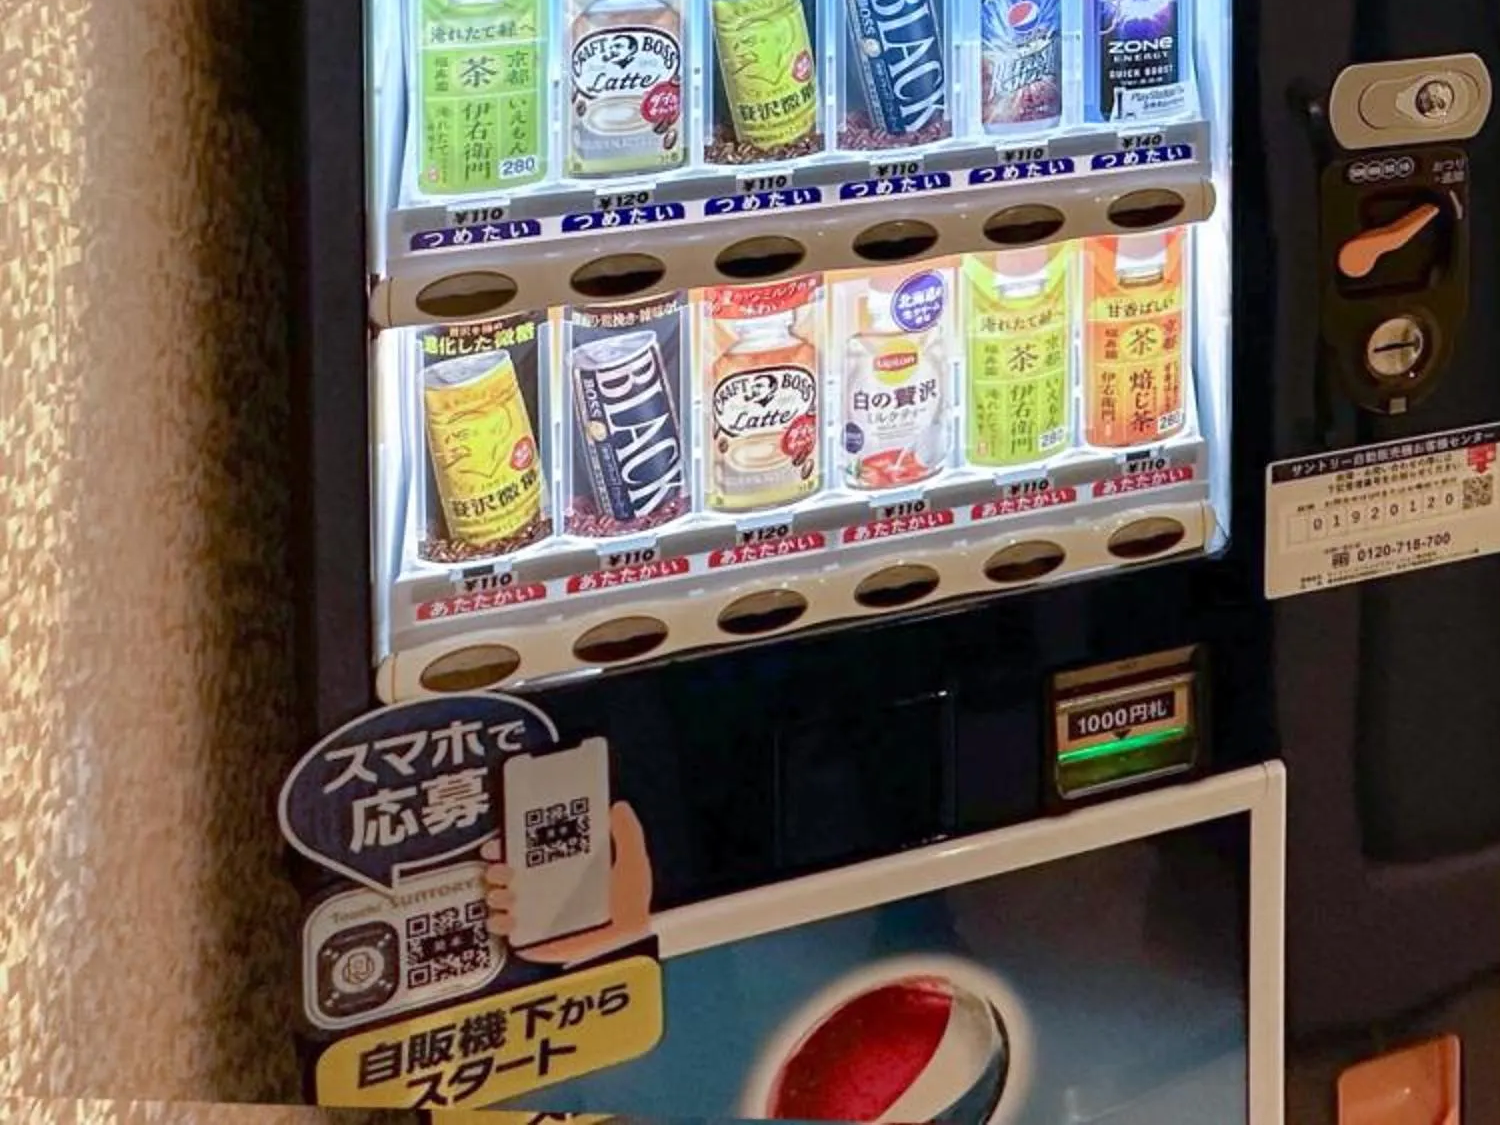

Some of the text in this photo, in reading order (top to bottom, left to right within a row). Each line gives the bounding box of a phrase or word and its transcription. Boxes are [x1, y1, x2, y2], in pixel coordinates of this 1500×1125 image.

[459, 55, 497, 88] 茶
[587, 73, 660, 93] Latte
[1121, 132, 1163, 148] ¥140
[501, 156, 536, 176] 280
[1004, 147, 1045, 162] ¥110
[1100, 145, 1184, 169] つめたい
[876, 161, 919, 176] ¥110
[979, 160, 1066, 182] つめたい
[742, 175, 787, 192] ¥110
[850, 174, 942, 197] つめたい
[598, 190, 650, 210] ¥120
[717, 188, 812, 212] つめたい
[453, 206, 503, 224] ¥110
[573, 205, 675, 230] つめたい
[423, 222, 530, 248] つめたい
[1126, 327, 1157, 356] 茶
[1007, 343, 1039, 373] 茶
[583, 377, 600, 418] BOSS
[853, 379, 937, 412] 白の贅沢
[1129, 368, 1155, 432] 焙じ茶
[729, 407, 799, 432] Latte
[595, 349, 683, 520] BLACK
[1128, 458, 1165, 473] ¥110
[1010, 479, 1049, 494] ¥110
[1103, 467, 1184, 494] あたたかい
[883, 501, 925, 517] ¥110
[982, 487, 1069, 518] あたたかい
[742, 525, 789, 542] ¥120
[853, 509, 944, 542] あたたかい
[608, 548, 655, 565] ¥110
[719, 531, 816, 565] あたたかい
[1357, 532, 1451, 562] 0120-718-700
[464, 574, 512, 591] ¥110
[578, 559, 680, 590] あたたかい
[428, 586, 535, 618] あたたかい
[1076, 701, 1168, 735] 1000円札
[322, 719, 527, 794] スマホで
[350, 765, 491, 854] 応募
[357, 982, 630, 1089] 自販機下から
[406, 1038, 577, 1109] スタート
